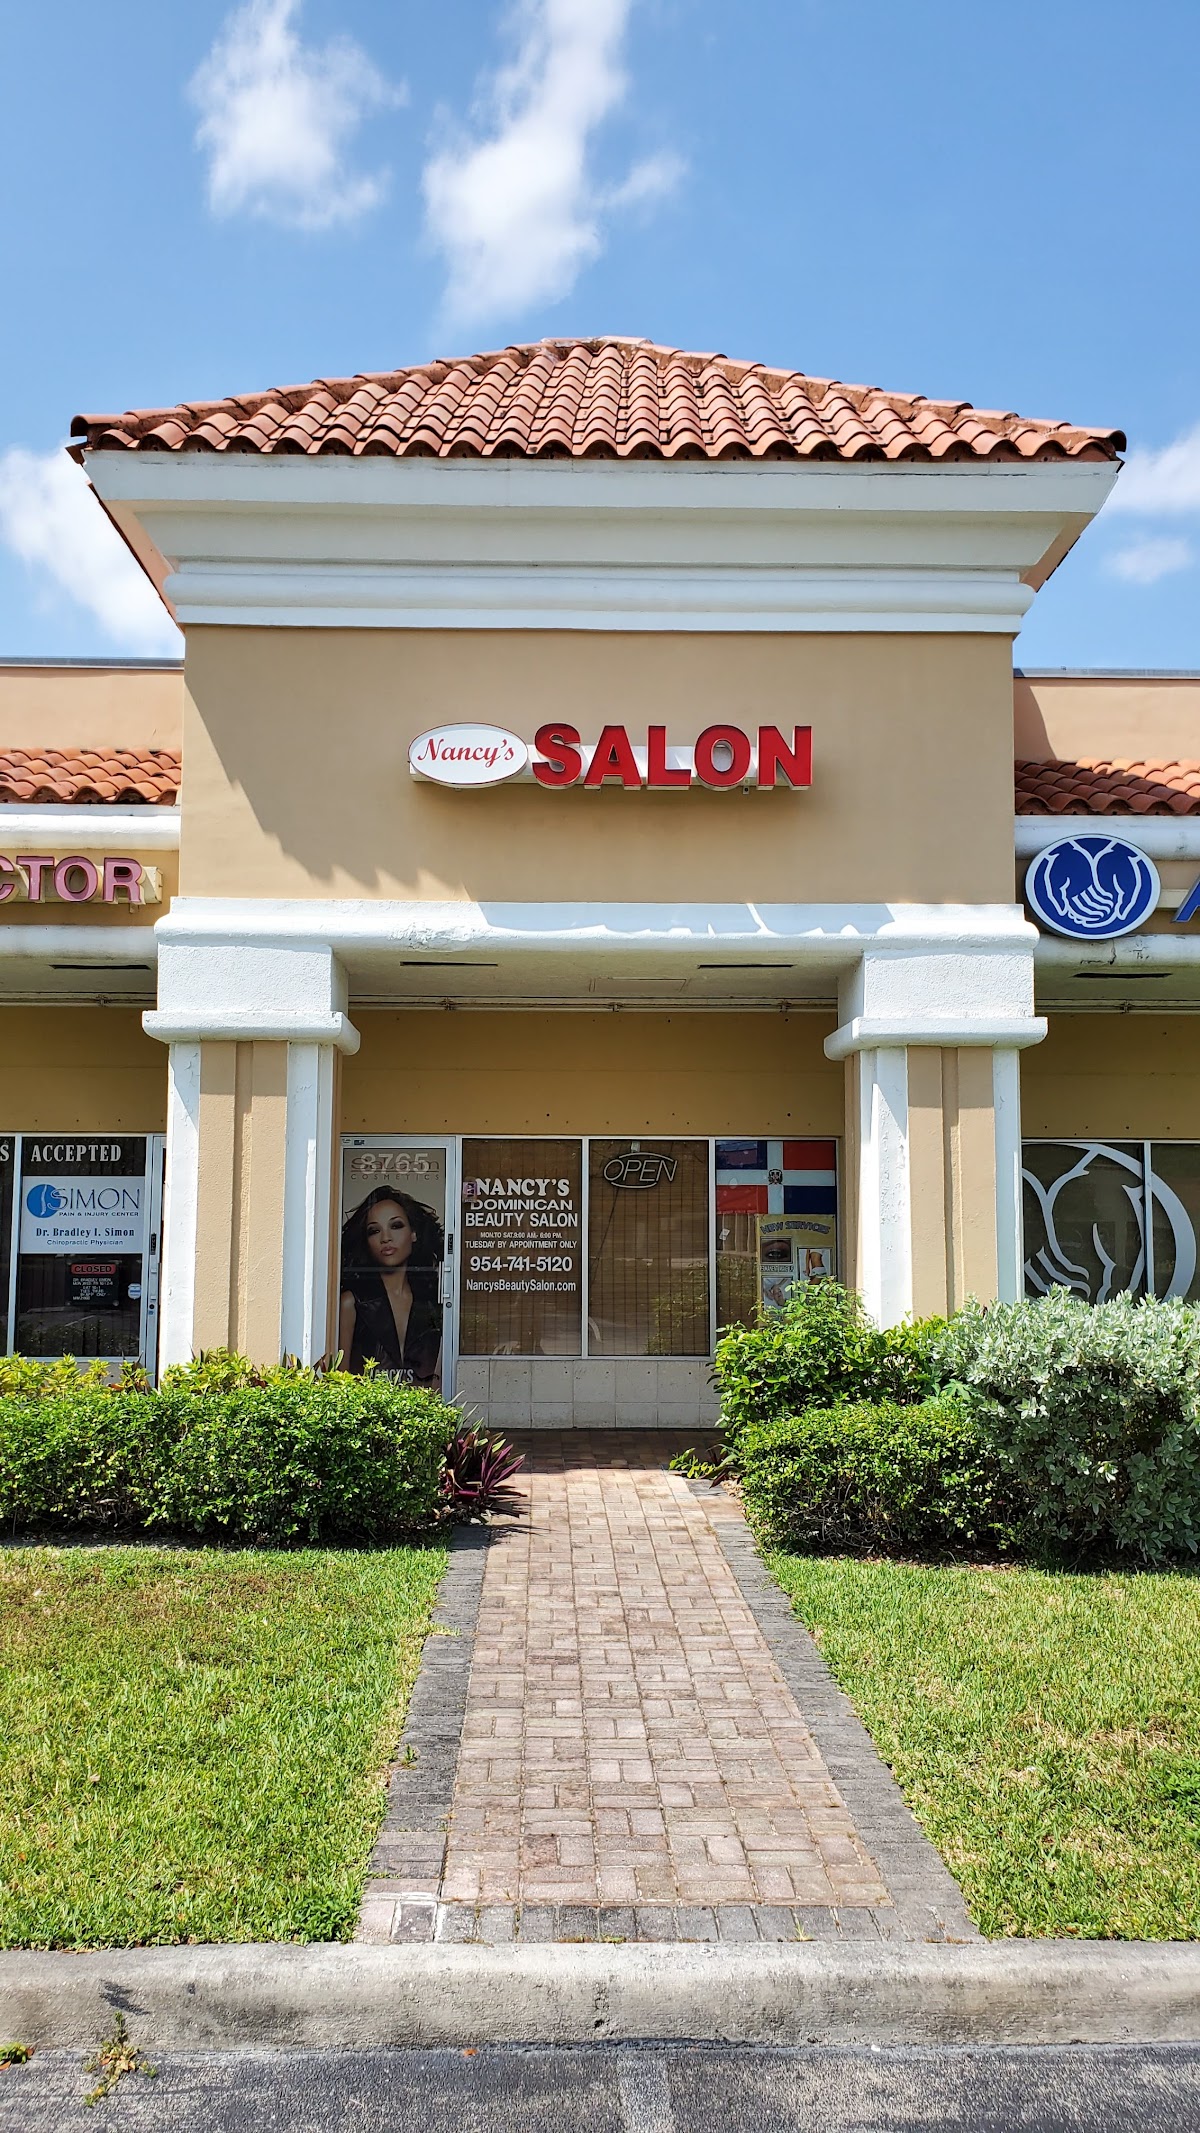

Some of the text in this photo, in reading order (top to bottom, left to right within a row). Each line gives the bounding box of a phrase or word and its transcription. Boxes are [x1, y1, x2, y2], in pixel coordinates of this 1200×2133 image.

[416, 738, 515, 768] Nancy's
[532, 723, 813, 789] SALON
[30, 1144, 122, 1162] ACCEPTED
[360, 1153, 430, 1175] 8765
[603, 1159, 678, 1182] OPEN
[350, 1173, 440, 1181] COSMETICS
[475, 1178, 570, 1197] NANCY'S
[47, 1187, 140, 1210] SIMON
[470, 1199, 573, 1211] DOMINICAN
[465, 1212, 578, 1227] BEAUTY SALON
[36, 1227, 50, 1237] Dr.
[53, 1227, 91, 1238] Bradley
[104, 1227, 135, 1237] Simon
[760, 1221, 831, 1234] NEW SERVICES
[465, 1241, 578, 1249] TUESDAY BY APPOINTMENT ONLY
[74, 1265, 112, 1273] CLOSED
[469, 1256, 573, 1272] 954-741-5120
[466, 1279, 577, 1293] NancysBeautySalon.com
